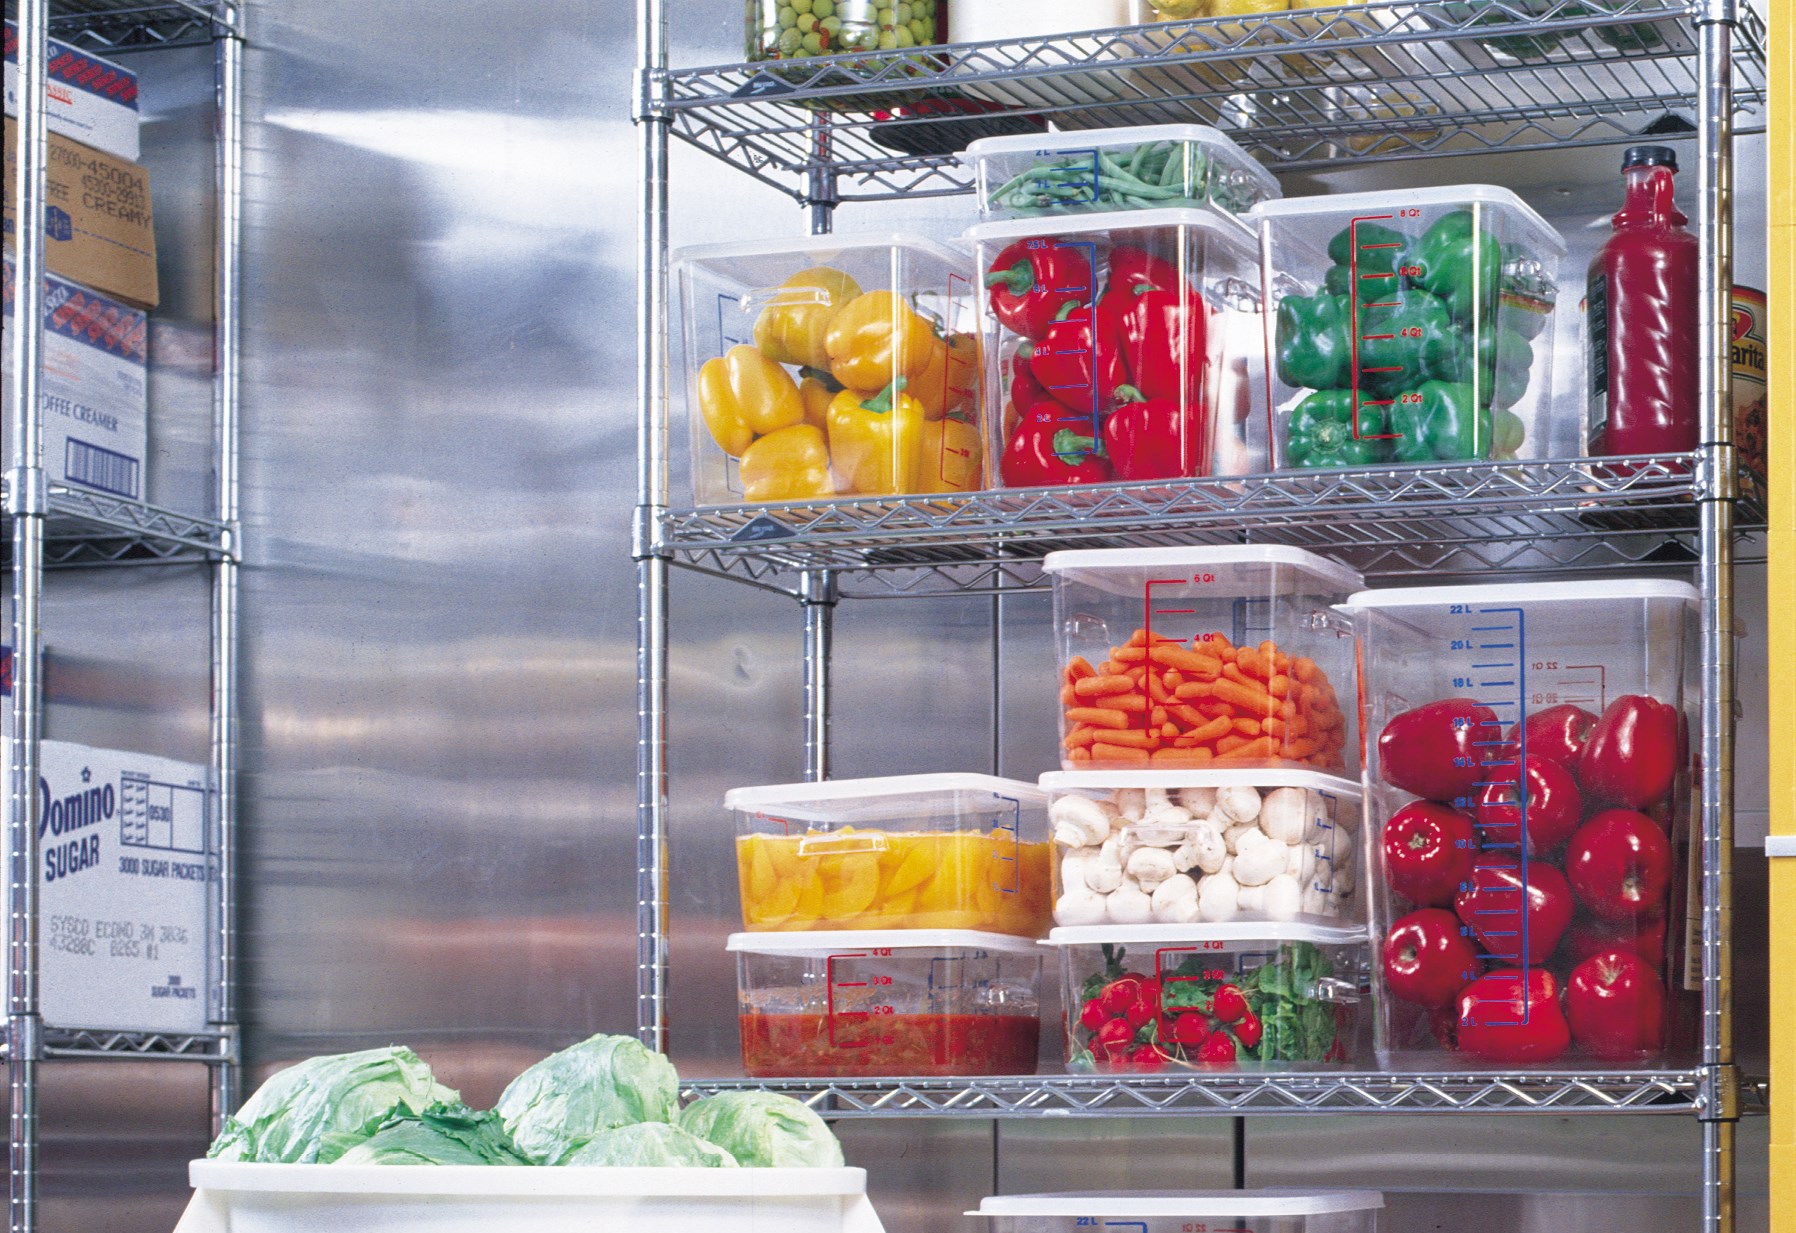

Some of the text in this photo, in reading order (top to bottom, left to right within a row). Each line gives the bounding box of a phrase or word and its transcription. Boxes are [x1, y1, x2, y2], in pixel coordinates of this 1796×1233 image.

[82, 192, 151, 229] CREAMY
[1401, 328, 1408, 337] 4
[1732, 344, 1765, 372] arita
[1401, 394, 1409, 404] 2
[43, 393, 119, 432] OFFEE CREAMER
[1450, 605, 1463, 614] 22
[1193, 633, 1200, 642] 4
[1450, 640, 1464, 650] 20
[1452, 678, 1464, 688] 18
[45, 833, 100, 883] SUGAR
[141, 859, 169, 879] SUGAR
[50, 915, 90, 935] SYSCO
[1203, 941, 1210, 950] 4
[872, 948, 879, 957] 4
[872, 976, 880, 985] 3
[874, 1006, 881, 1015] 2
[1461, 1017, 1469, 1027] 2
[1076, 1217, 1089, 1226] 22
